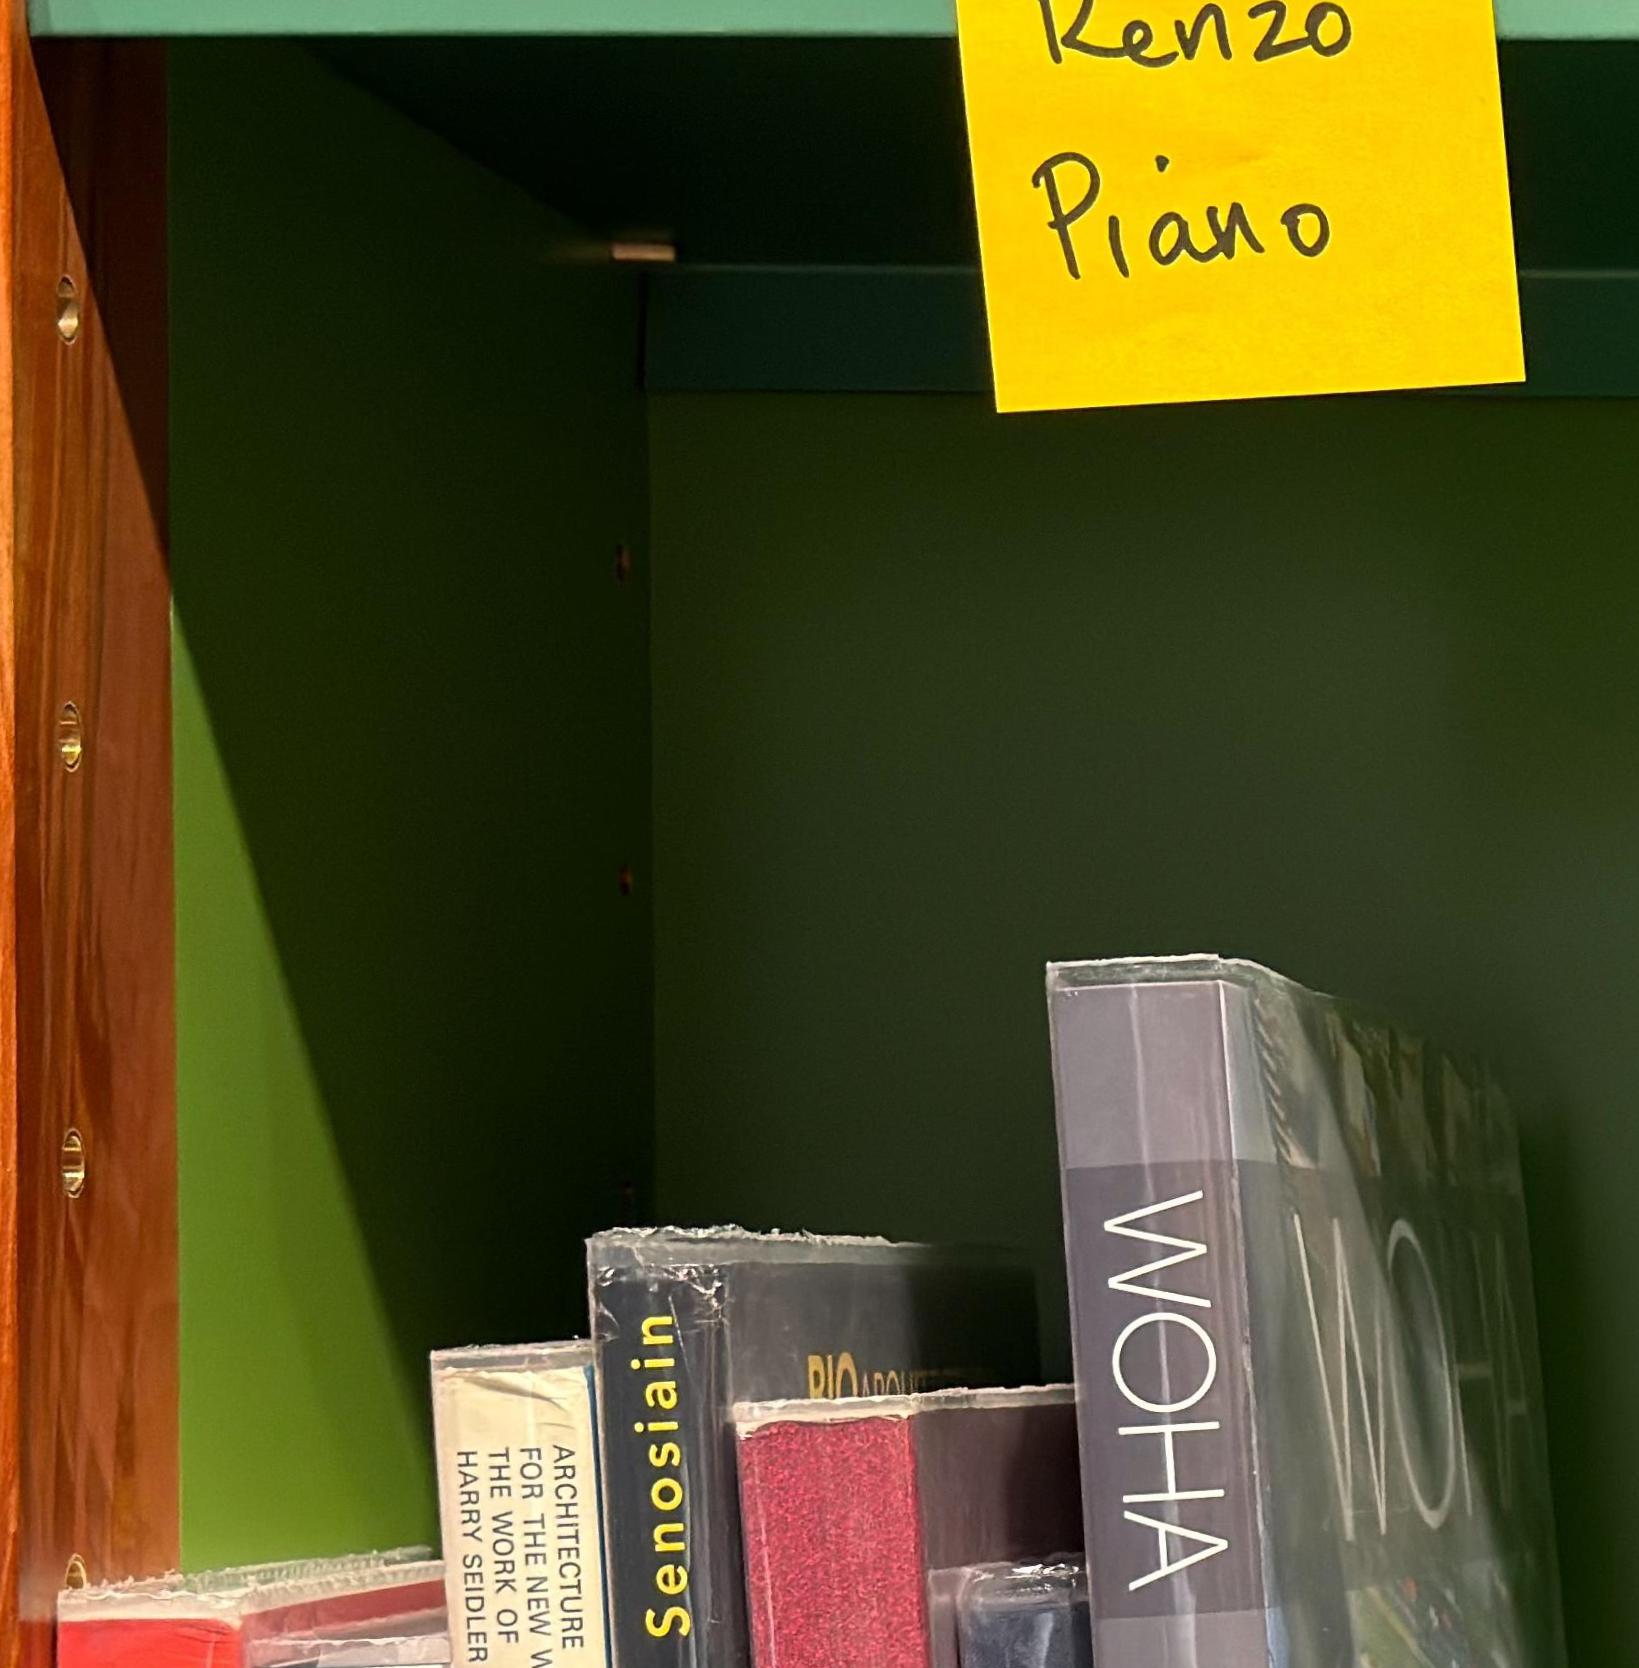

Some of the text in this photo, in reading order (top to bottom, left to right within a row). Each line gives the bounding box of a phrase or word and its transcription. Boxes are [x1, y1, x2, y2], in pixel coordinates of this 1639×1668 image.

[1031, 151, 1331, 280] Piano
[518, 1446, 544, 1500] FOR
[630, 1314, 692, 1639] Senosiain
[1102, 1189, 1228, 1591] WOHA
[455, 1450, 488, 1663] HARRY SEIDLER
[487, 1446, 519, 1643] THE WORK OF
[522, 1512, 546, 1566] THE
[524, 1575, 551, 1637] NEW
[551, 1443, 585, 1649] ARCHITECTURE
